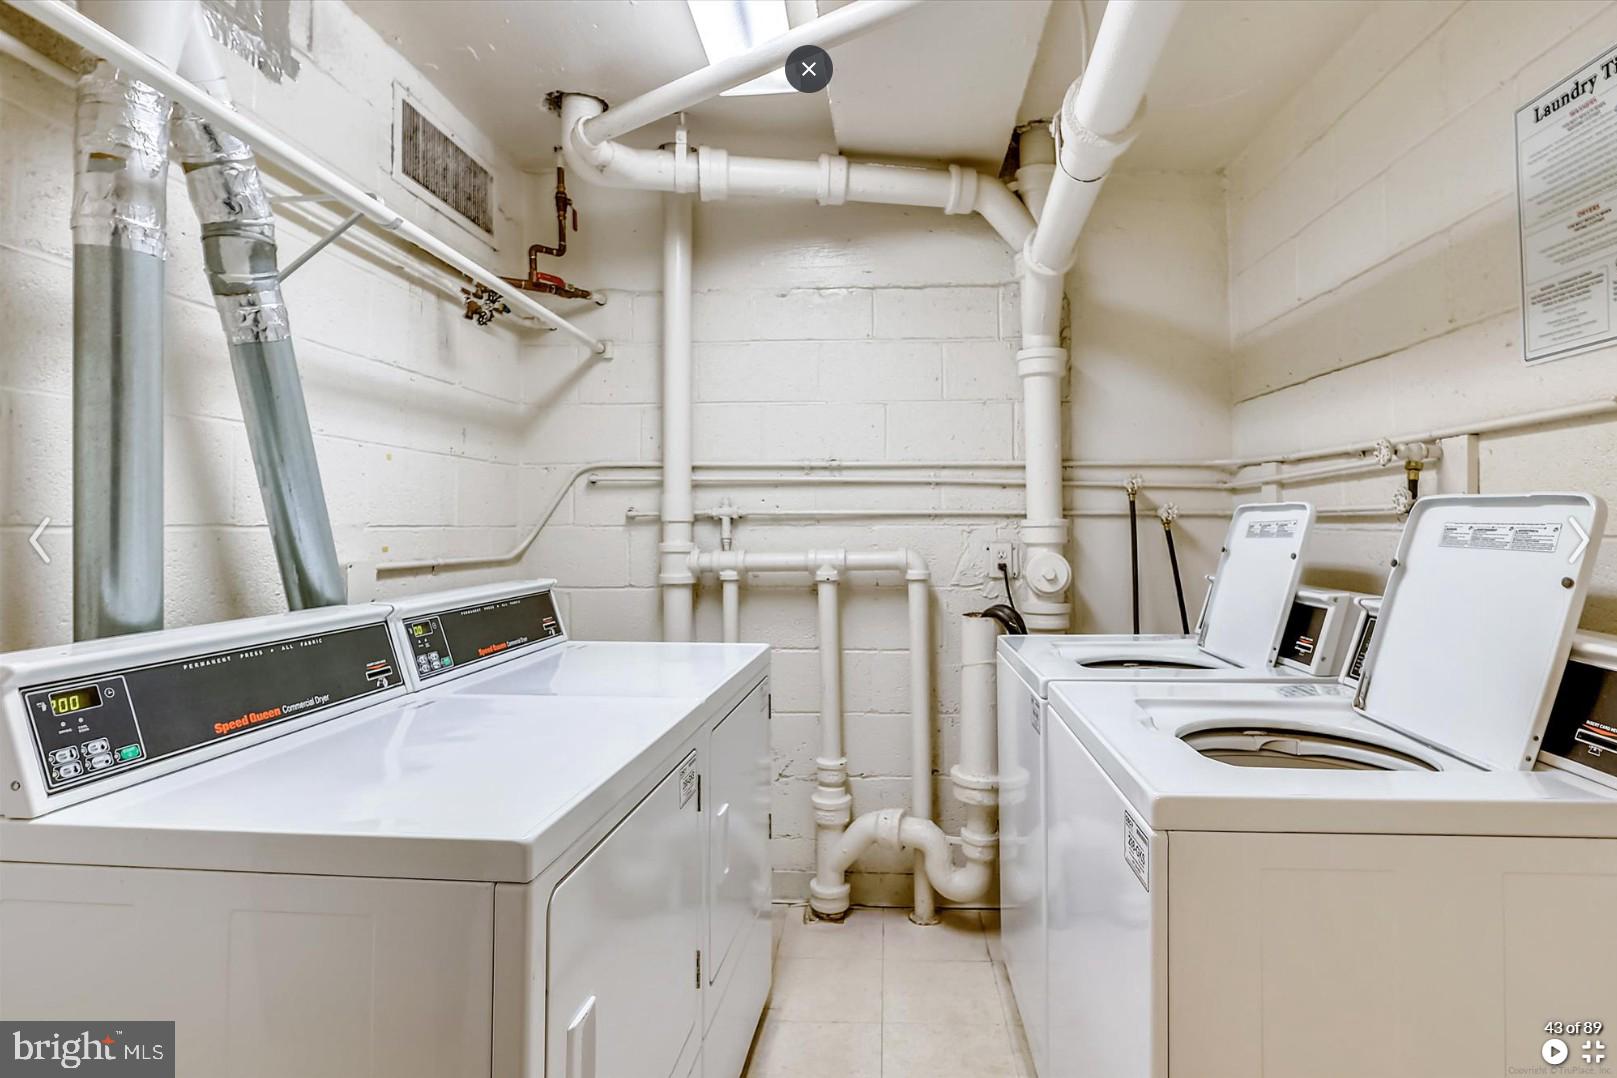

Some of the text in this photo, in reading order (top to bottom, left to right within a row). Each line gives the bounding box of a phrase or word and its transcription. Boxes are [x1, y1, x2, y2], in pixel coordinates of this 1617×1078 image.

[1534, 74, 1597, 123] Laundry
[183, 655, 231, 670] PERMANENT
[240, 649, 263, 659] PRESS
[300, 638, 322, 647] FABRIC
[214, 694, 329, 734] Speed Queen Commercial Dryer
